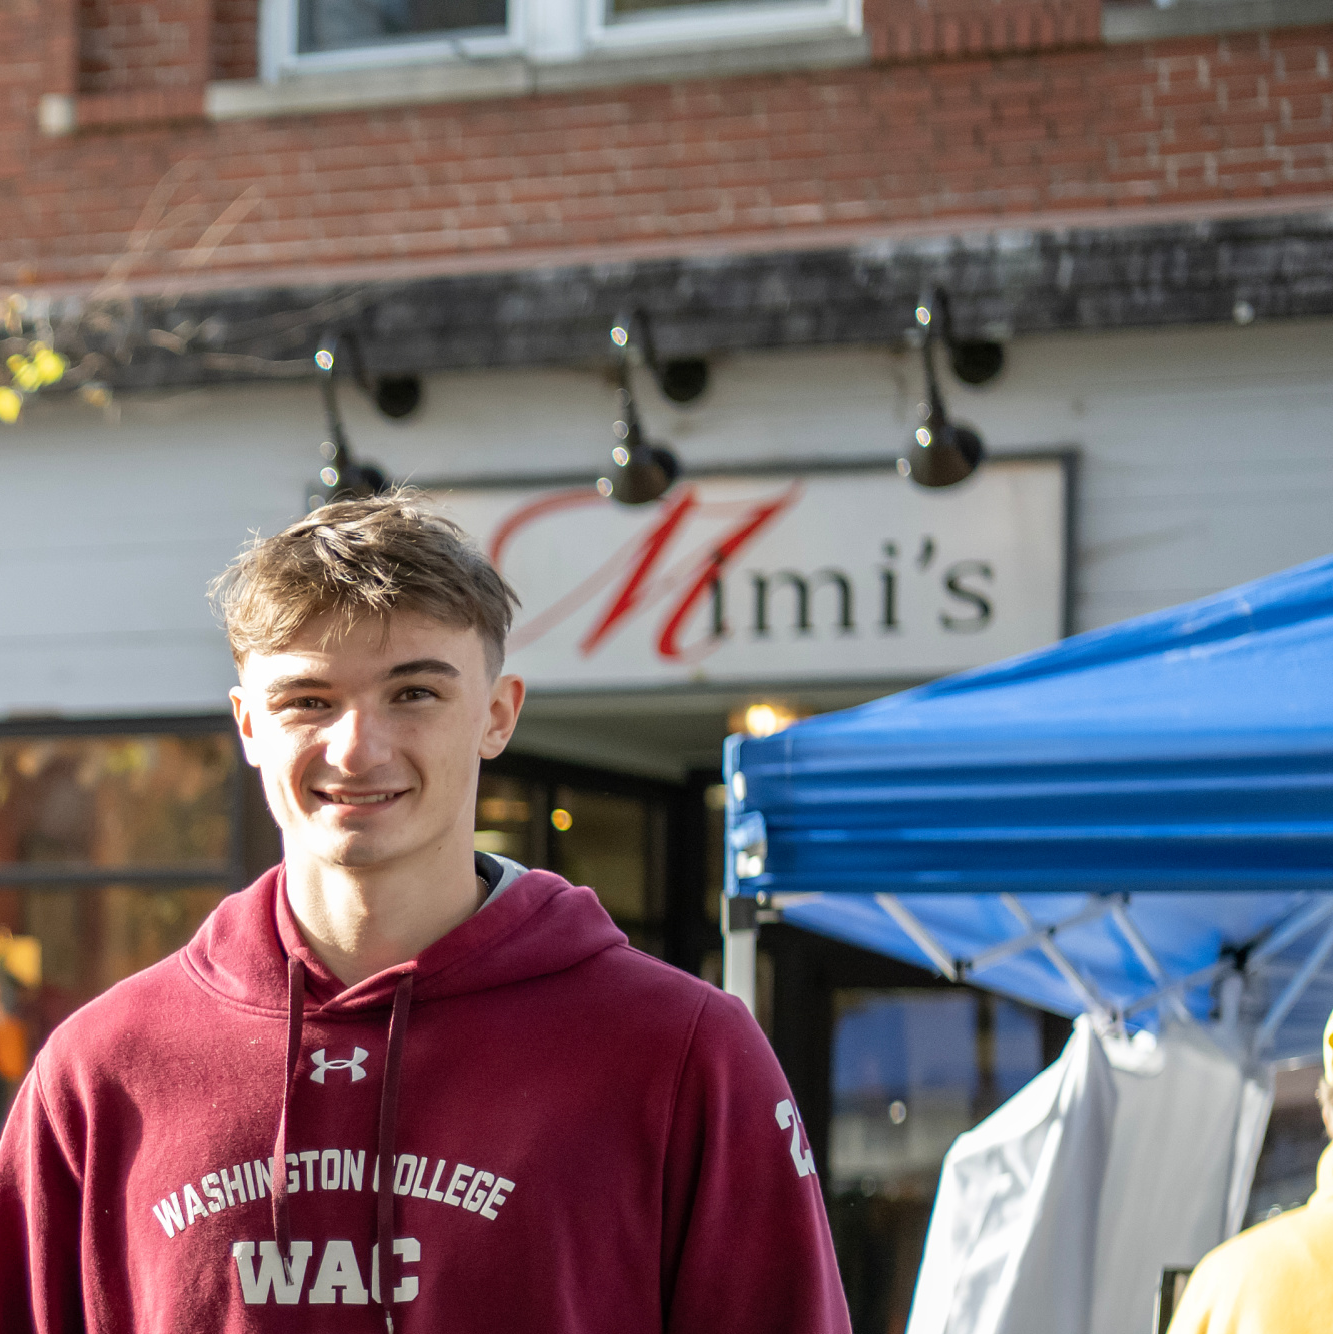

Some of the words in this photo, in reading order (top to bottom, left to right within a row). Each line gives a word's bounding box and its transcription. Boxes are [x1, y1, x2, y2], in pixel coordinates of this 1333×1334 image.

[490, 480, 996, 662] Mimi's
[774, 1098, 816, 1177] 2
[152, 1149, 366, 1239] WASHINGTON
[232, 1237, 421, 1305] WAC
